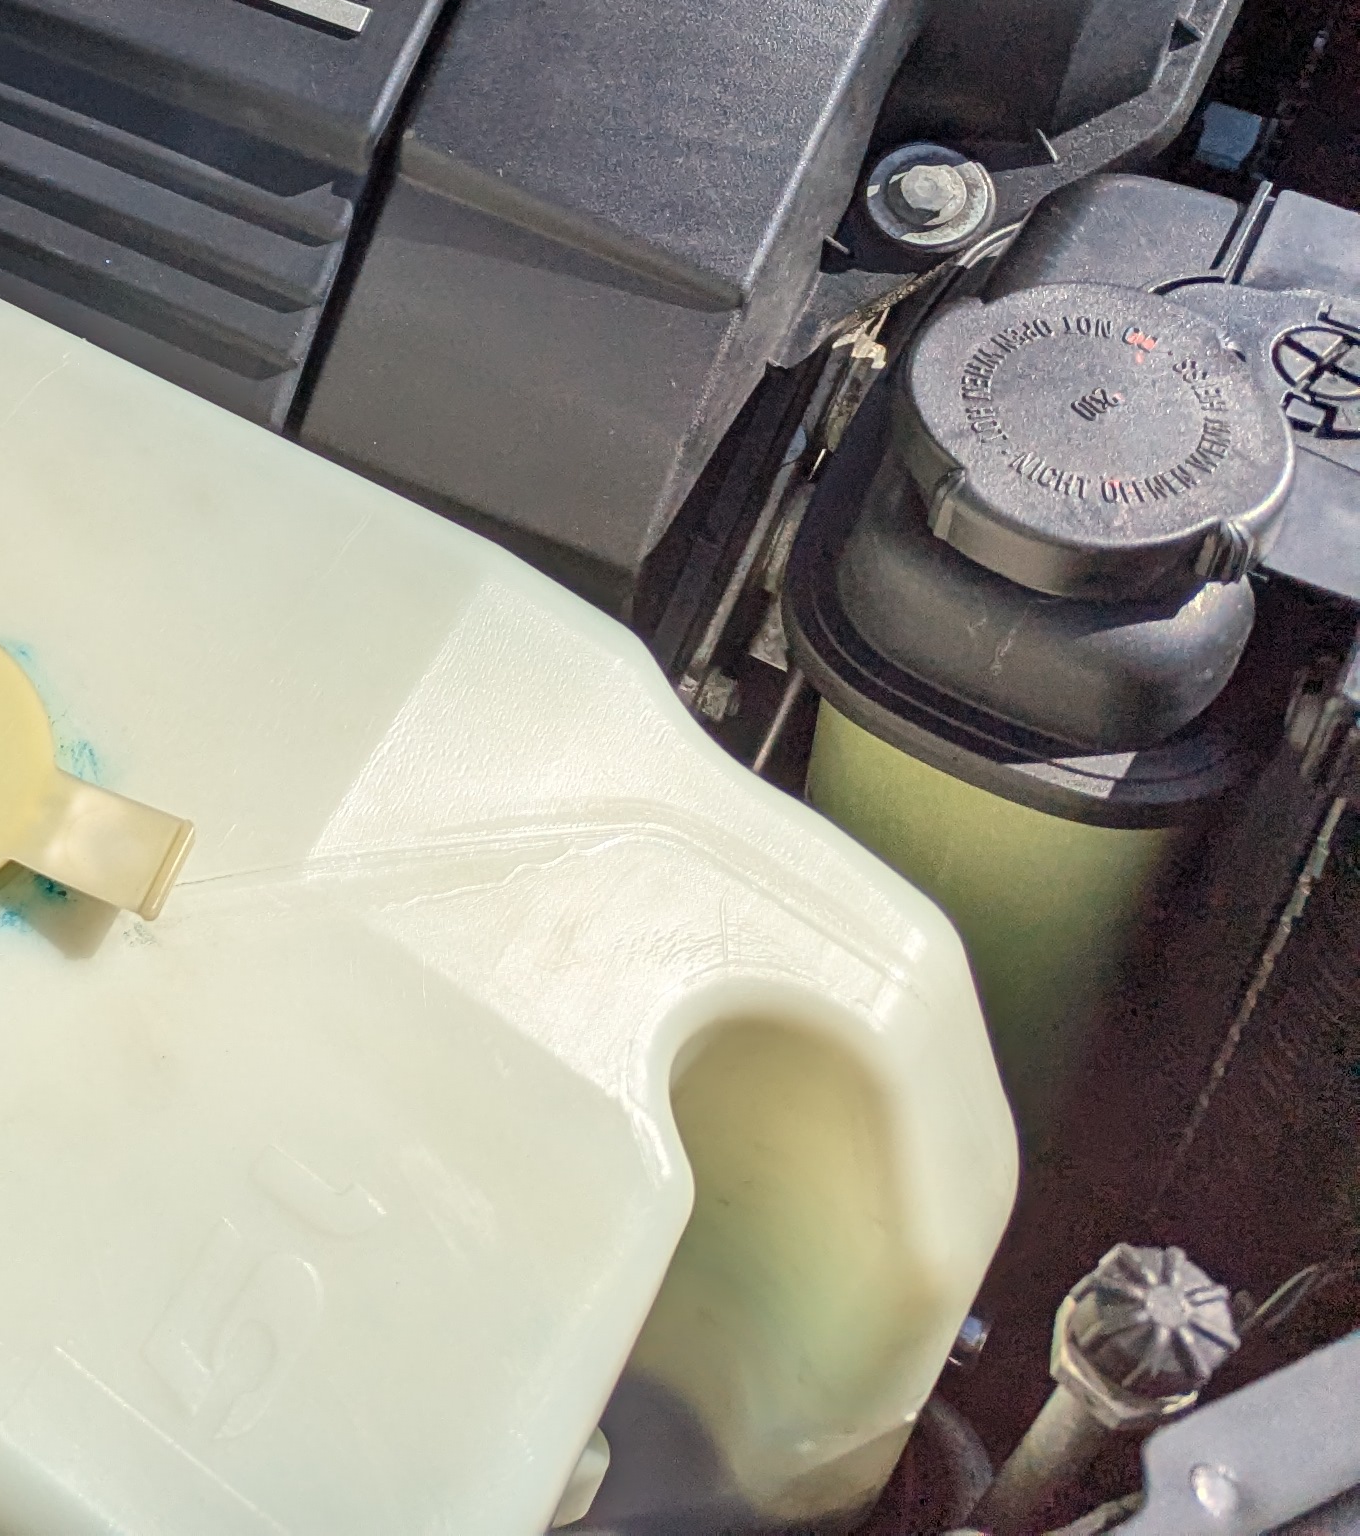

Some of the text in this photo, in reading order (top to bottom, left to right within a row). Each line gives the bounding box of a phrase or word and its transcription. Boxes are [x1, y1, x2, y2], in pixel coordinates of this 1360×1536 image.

[989, 317, 1054, 356] OPEN
[1061, 315, 1113, 340] NOT
[960, 346, 1006, 404] WHEN
[1008, 450, 1090, 501] NICHT
